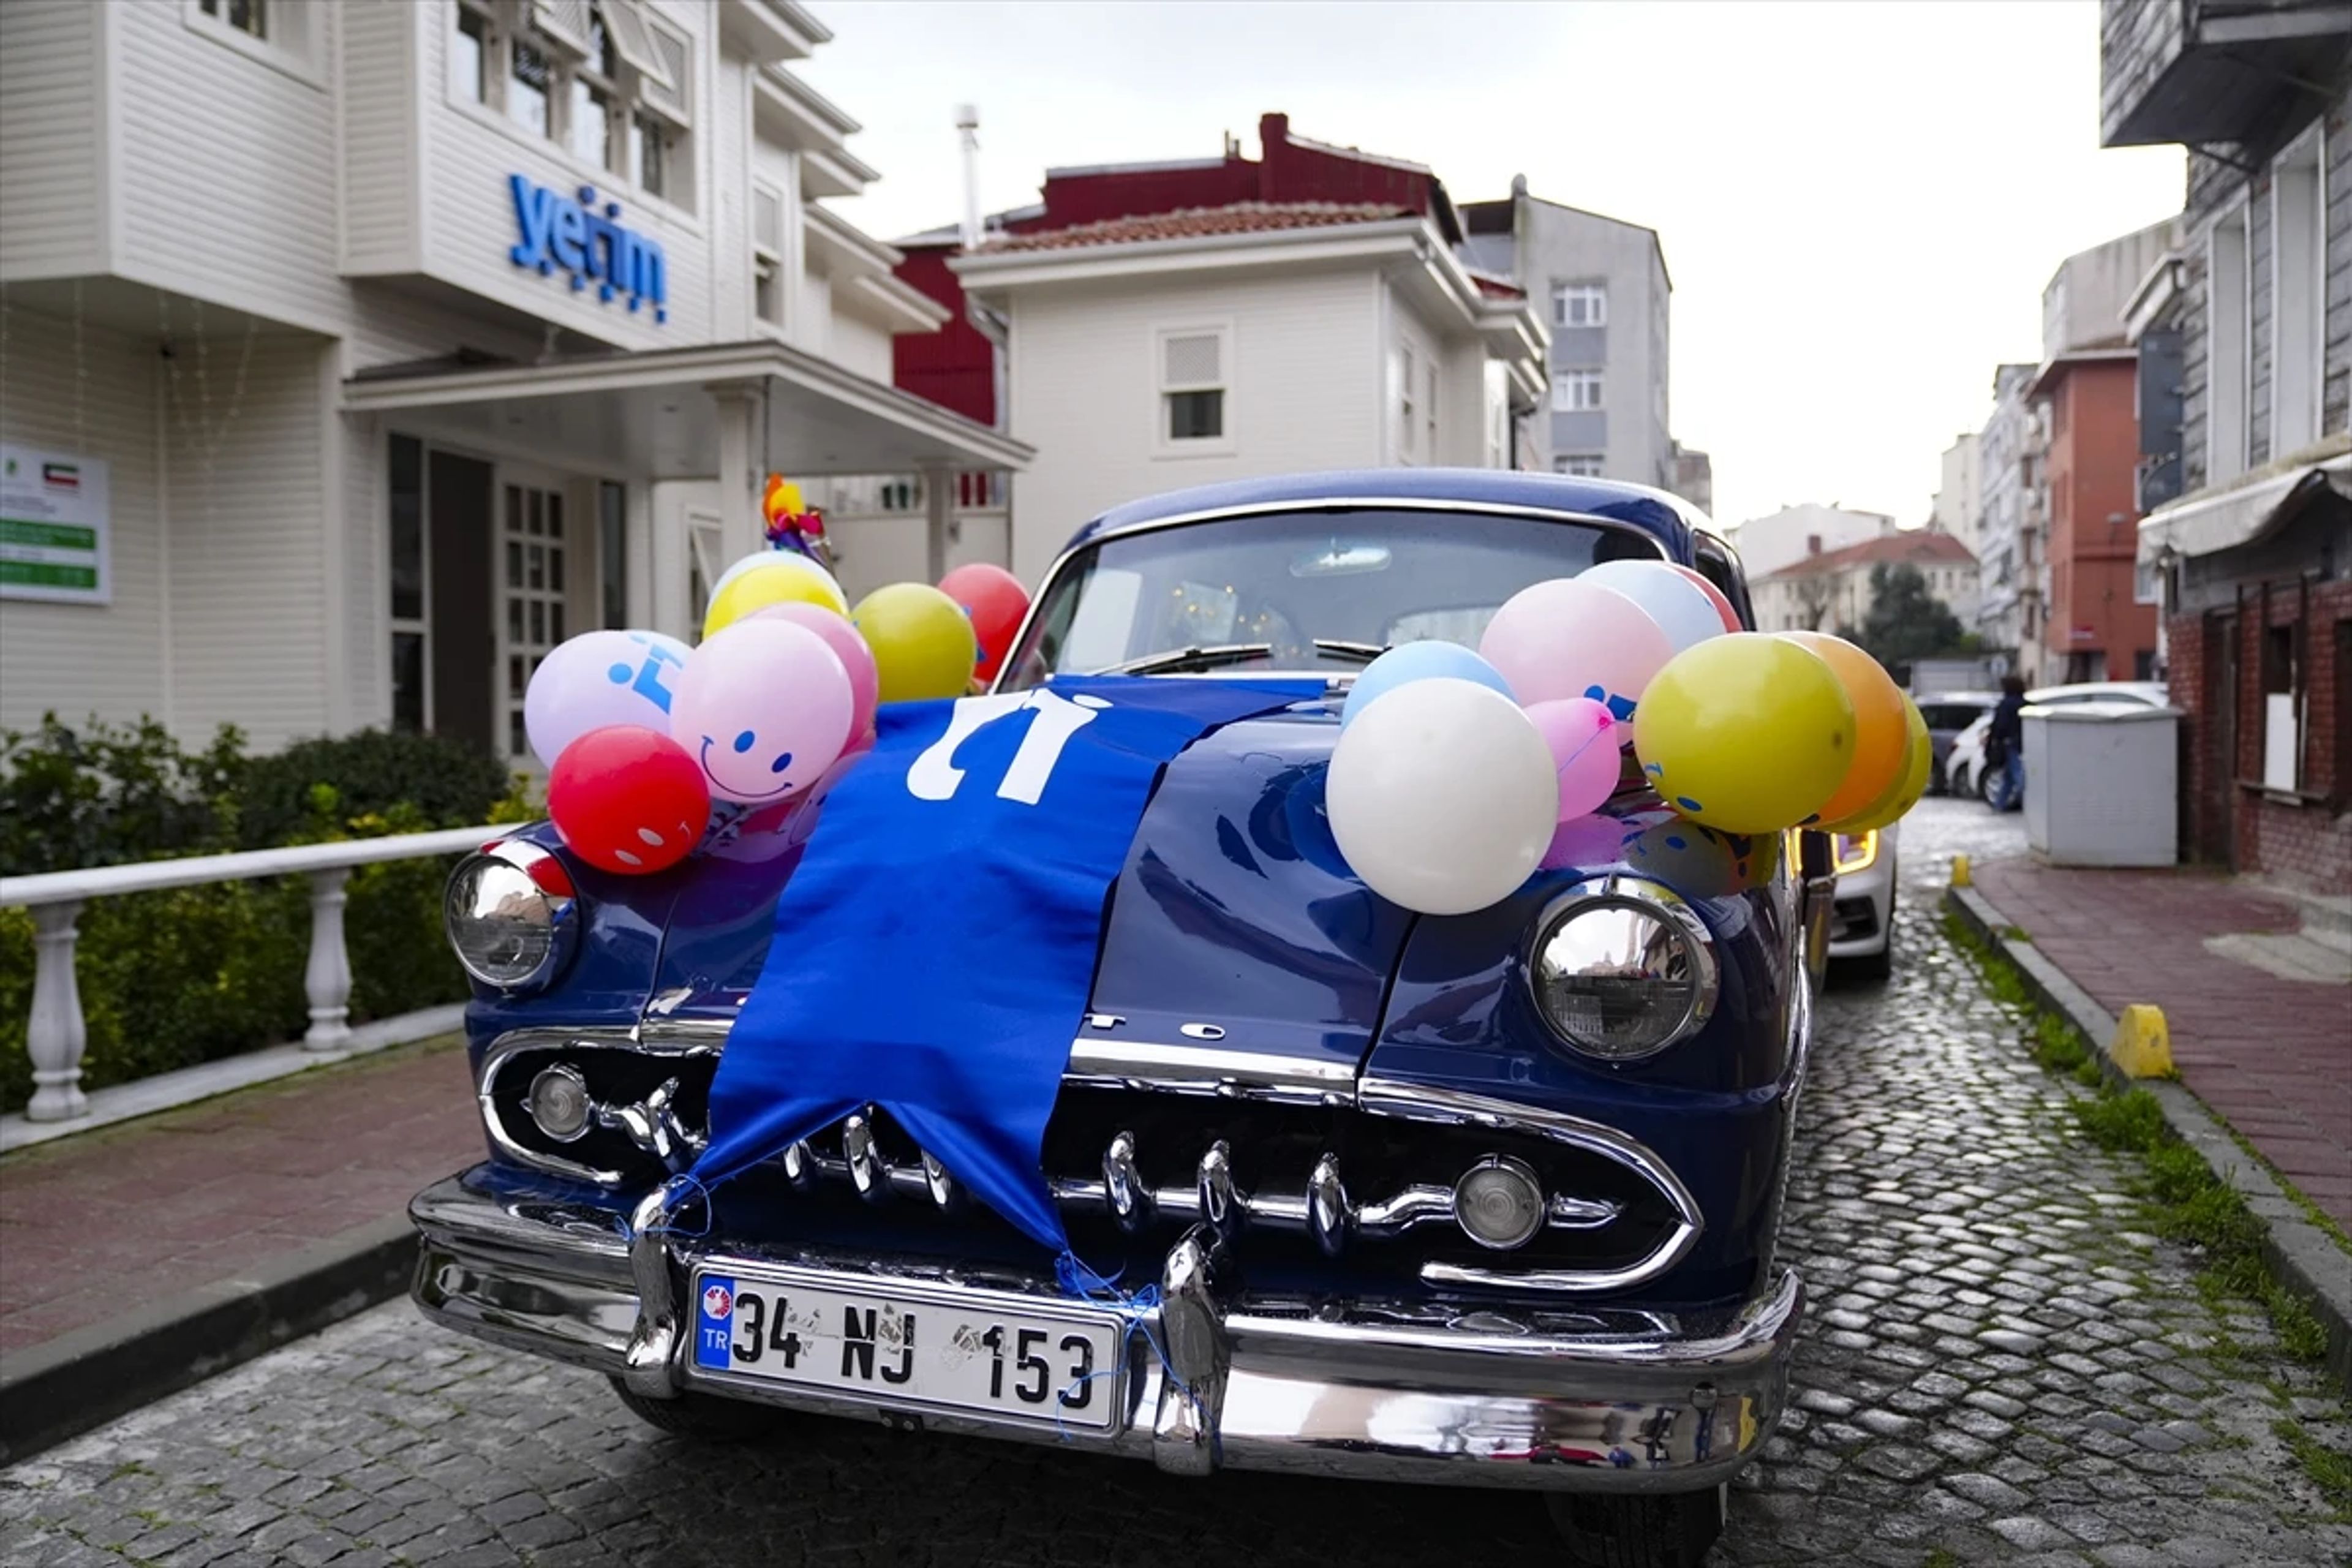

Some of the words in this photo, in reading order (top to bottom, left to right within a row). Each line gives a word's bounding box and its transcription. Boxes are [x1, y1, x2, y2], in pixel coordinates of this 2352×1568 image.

[704, 1328, 728, 1350] TR
[733, 1292, 801, 1369] 34
[841, 1305, 915, 1384] NJ
[981, 1325, 1094, 1409] 153
